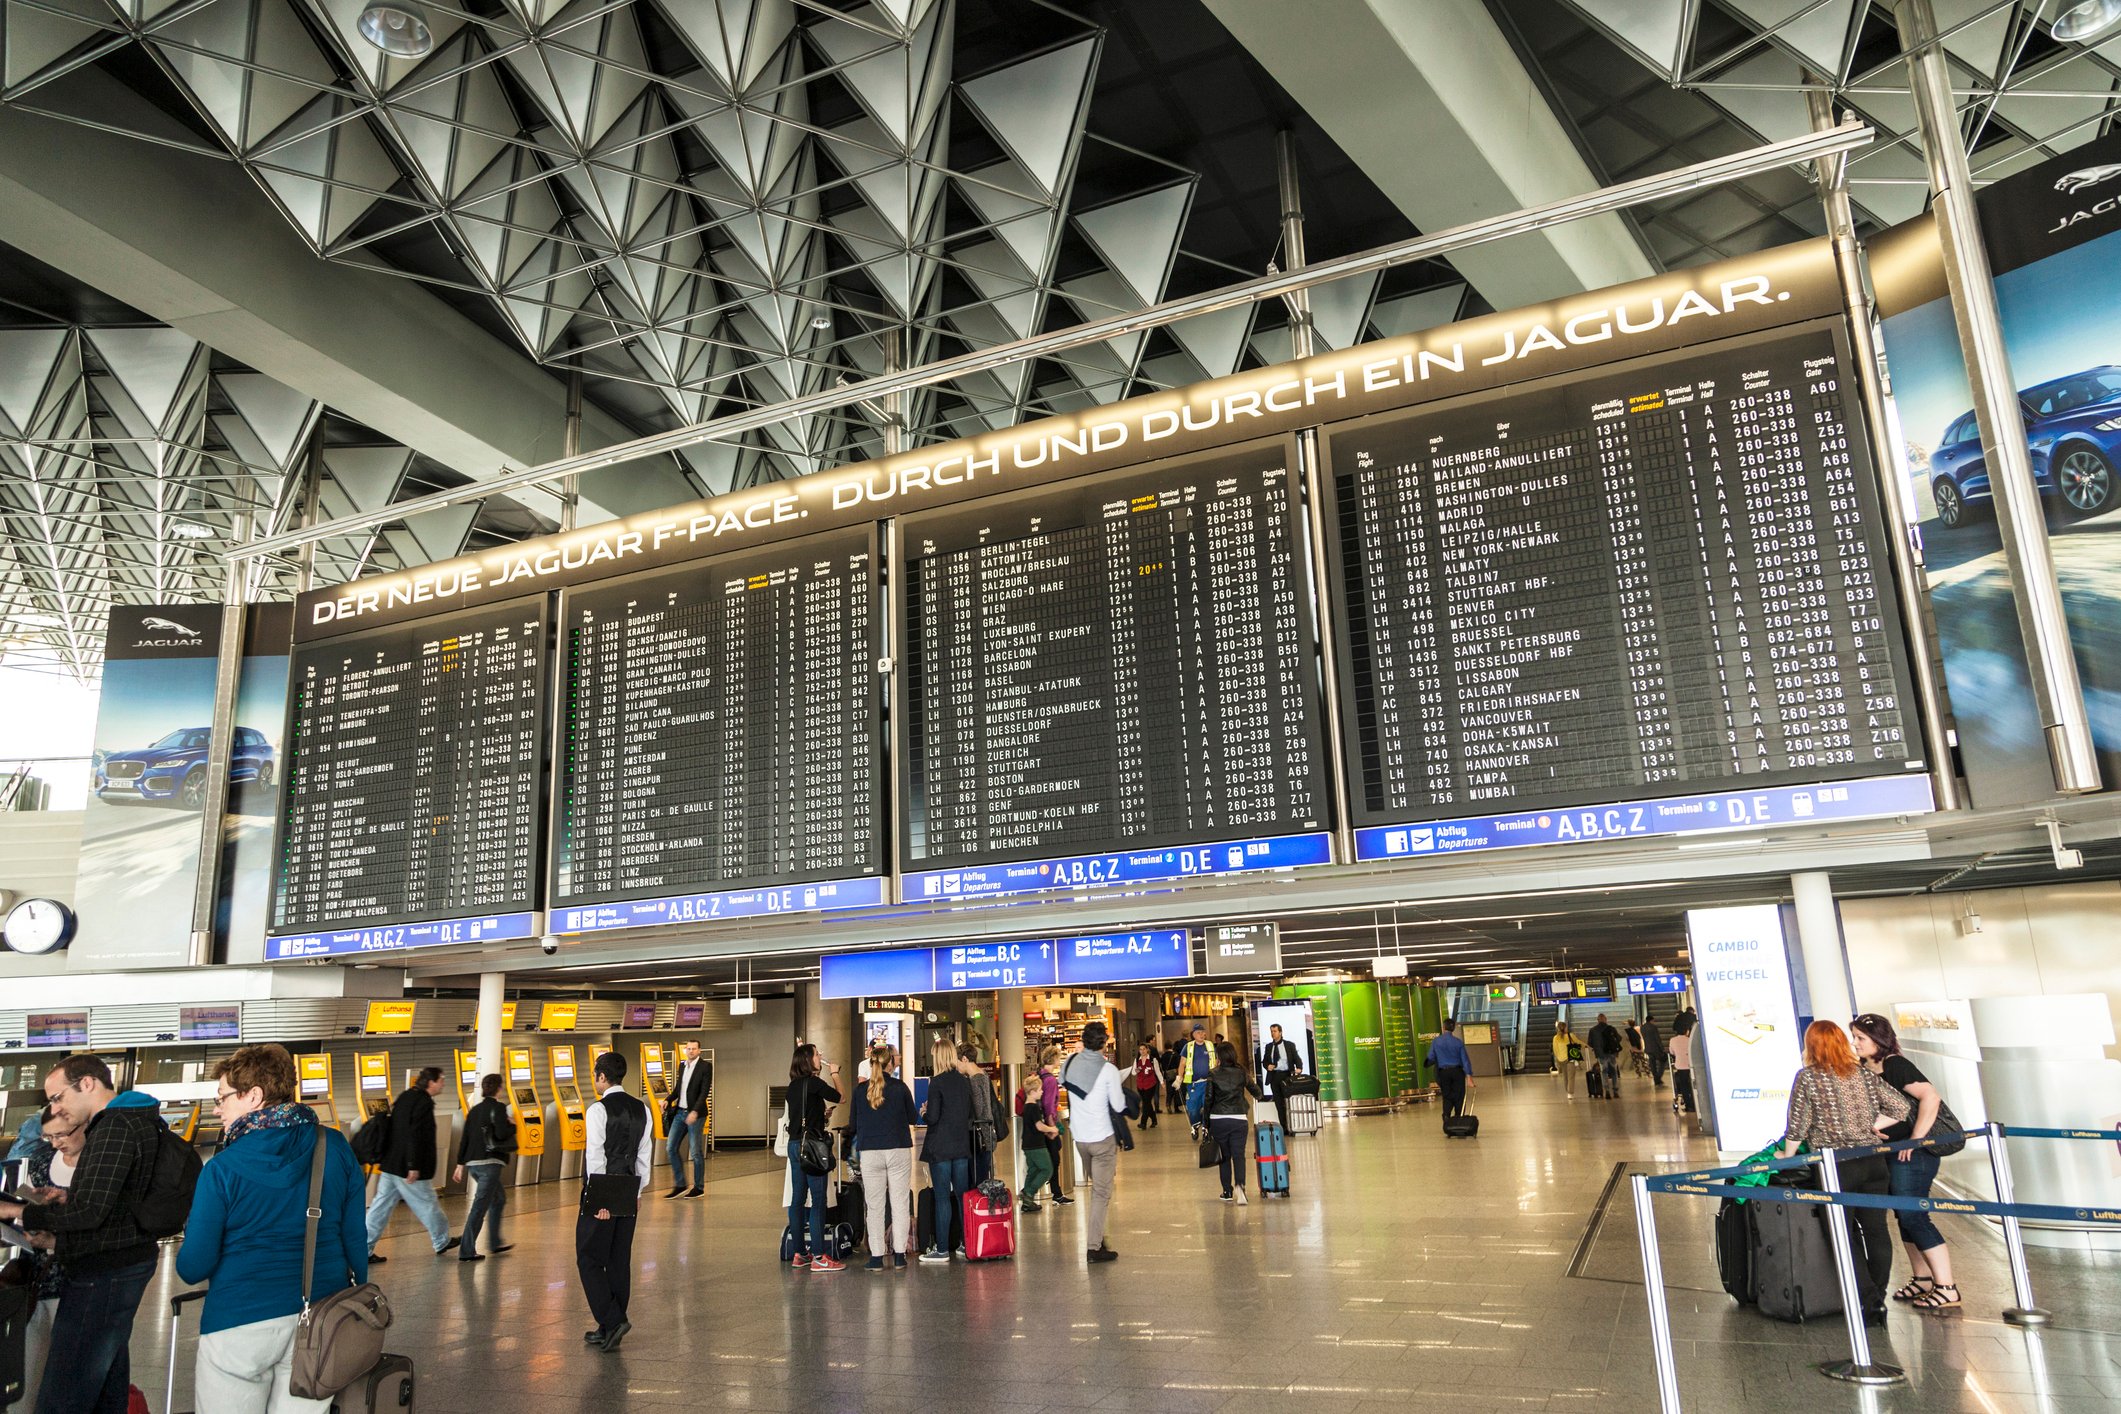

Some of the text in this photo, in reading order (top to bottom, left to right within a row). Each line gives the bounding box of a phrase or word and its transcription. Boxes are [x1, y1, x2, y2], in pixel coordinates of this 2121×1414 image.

[2048, 194, 2121, 234] JAG
[1804, 356, 1835, 369] Flugsteig
[1742, 369, 1769, 381] Schalter
[1806, 368, 1822, 377] Gate
[1665, 385, 1691, 396] Terminal
[1699, 380, 1715, 390] Halle
[1744, 378, 1770, 390] Counter
[1629, 391, 1659, 404] erwartet
[1667, 394, 1694, 406] Terminal
[1701, 390, 1713, 399] Hall
[1593, 408, 1624, 420] scheduled
[1631, 400, 1664, 413] estimated
[1429, 436, 1443, 444] nach
[312, 274, 1792, 625] DER NEUE JAGUAR F-PACE. DURCH UND DURCH EIN JAGUAR.
[1357, 452, 1368, 460] Flug
[1432, 446, 1500, 469] NUERNBERG
[1433, 445, 1572, 482] MAILAND-ANNULLIERT
[1435, 477, 1481, 495] BREMEN
[1436, 474, 1568, 508] WASHINGTON-DULLES
[1438, 504, 1483, 522] MADRID
[1440, 517, 1486, 535] MALAGA
[1441, 521, 1542, 548] LEIPZIG/HALLE
[980, 535, 1050, 557] BERLIN-TEGEL
[1442, 532, 1560, 562] NEW YORK-NEWARK
[981, 555, 1070, 581] WROCLAW/BRESLAU
[1444, 558, 1490, 575] ALMATY
[982, 580, 1064, 604] CHICAGO-O HARE
[1447, 581, 1516, 602] STUTTGART
[1448, 599, 1495, 616] DENVER
[1450, 607, 1535, 630] MEXICO CITY
[132, 638, 202, 648] JAGUAR
[984, 625, 1091, 652] LYON-SAINT EXUPERY
[1451, 625, 1514, 644] BRUESSEL
[1453, 629, 1581, 658] SANKT PETERSBURG
[984, 646, 1037, 664] BARCELONA
[1454, 645, 1573, 672] DUESSELDORF HBF
[1456, 667, 1520, 686] LISSABON
[986, 676, 1081, 700] ISTANBUL-ATATURK
[1458, 682, 1512, 700] CALGARY
[986, 699, 1101, 725] MUENSTER/OSNABRUECK
[1461, 709, 1532, 728] VANCOUVER
[987, 747, 1029, 762] ZUERICH
[1464, 735, 1559, 757] OSAKA-KANSAI
[1466, 754, 1530, 771] HANNOVER
[1467, 771, 1508, 786] TAMPA
[988, 779, 1080, 800] OSLO-GARDERMOEN
[1469, 785, 1515, 800] MUMBAI
[989, 802, 1100, 825] DORTMUND-KOELN HBF
[1658, 803, 1703, 817] Terminal
[1727, 796, 1770, 824] D,E
[989, 820, 1063, 837] PHILADELPHIA
[1436, 825, 1467, 838] Abflug
[1494, 818, 1536, 831] Terminal
[1438, 835, 1488, 849] Departures
[1129, 854, 1163, 865] Terminal
[1181, 849, 1211, 874] D,E
[963, 871, 986, 883] Abflug
[1007, 866, 1038, 877] Terminal
[963, 880, 1001, 892] Departures
[728, 894, 754, 904] Terminal
[768, 890, 792, 911] D,E
[633, 904, 657, 914] Terminal
[998, 945, 1020, 963] B,C
[1127, 936, 1152, 955] A,Z
[1708, 940, 1758, 952] CAMBIO
[1003, 968, 1026, 985] D,E
[1645, 977, 1655, 990] Z
[1706, 969, 1768, 981] WECHSEL
[868, 1001, 904, 1009] ELECTRONICS
[1676, 1184, 1708, 1193] Lufthansa
[1796, 1192, 1832, 1202] Lufthansa
[1934, 1201, 1976, 1212] Lufthansa
